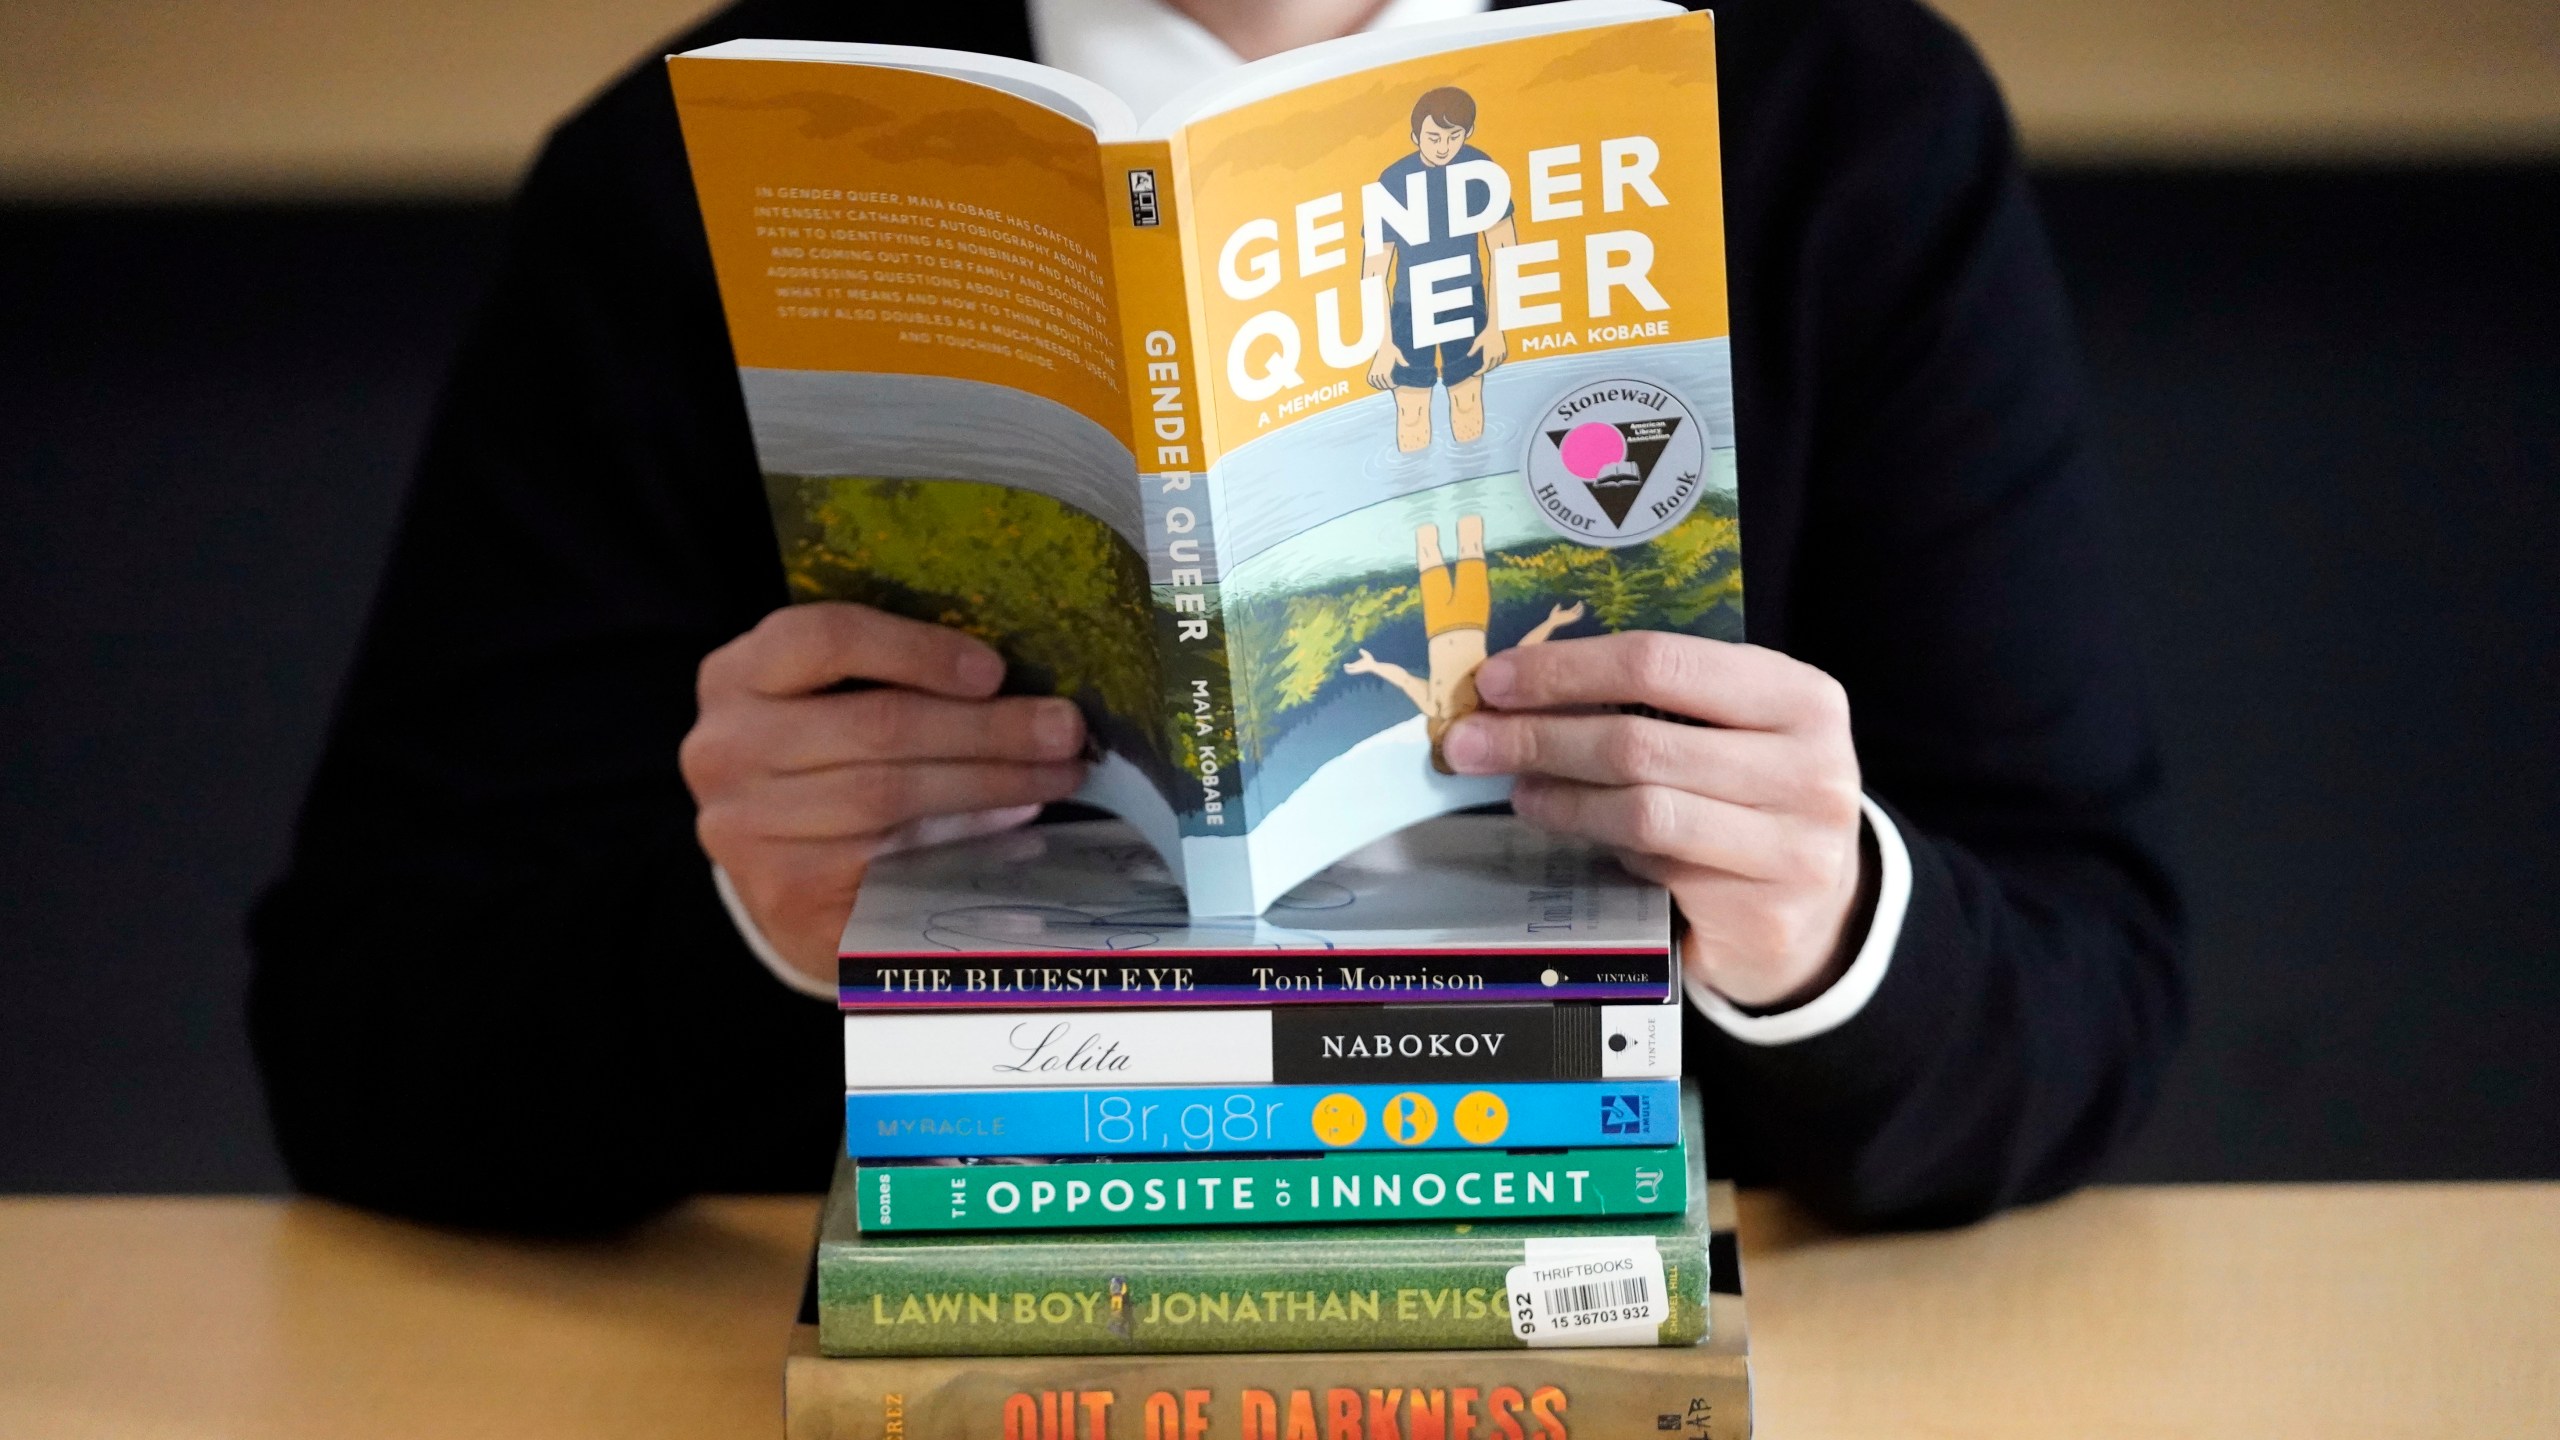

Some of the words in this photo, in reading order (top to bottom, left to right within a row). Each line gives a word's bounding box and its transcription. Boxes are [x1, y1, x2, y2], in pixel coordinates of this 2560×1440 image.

[755, 187, 774, 198] IN
[777, 187, 842, 200] GENDER
[847, 191, 904, 206] QUEER,
[907, 195, 945, 210] MAIA
[948, 201, 1003, 223] KOBABE
[1006, 215, 1031, 232] HAS
[1033, 224, 1082, 255] CRAFTED
[1085, 249, 1098, 264] AN
[1217, 135, 1670, 301] GENDER
[754, 206, 841, 221] INTENSELY
[847, 210, 936, 228] CATHARTIC
[939, 219, 1050, 257] AUTOBIOGRAPHY
[1053, 251, 1087, 277] ABOUT
[1089, 270, 1104, 287] EIR
[756, 226, 800, 238] PATH
[803, 227, 826, 240] TO
[830, 229, 932, 248] IDENTIFYING
[935, 238, 953, 250] AS
[956, 241, 1035, 269] NONBINARY
[1038, 263, 1061, 281] AND
[767, 266, 869, 281] ADDRESSING
[873, 271, 962, 290] QUESTIONS
[966, 281, 1011, 300] ABOUT
[1015, 293, 1063, 320] GENDER
[771, 247, 805, 259] AND
[808, 247, 874, 262] COMING
[877, 251, 910, 264] OUT
[913, 254, 936, 267] TO
[940, 257, 963, 271] EIR
[966, 262, 1016, 283] FAMILY
[1019, 277, 1045, 293] AND
[1095, 311, 1107, 326] BY
[776, 287, 822, 298] WHAT
[827, 288, 843, 299] IT
[847, 288, 901, 302] MEANS
[905, 293, 937, 306] AND
[941, 297, 977, 311] HOW
[981, 302, 1000, 316] TO
[1002, 307, 1042, 329] THINK
[1045, 321, 1082, 346] ABOUT
[777, 306, 830, 318] STORY
[834, 308, 877, 321] ALSO
[880, 310, 954, 327] DOUBLES
[956, 318, 976, 330] AS
[979, 320, 988, 332] A
[1226, 230, 1672, 401] QUEER
[1522, 332, 1578, 353] MAIA
[1587, 320, 1670, 345] KOBABE
[899, 330, 932, 344] AND
[935, 334, 1013, 358] TOUCHING
[1145, 330, 1192, 494] GENDER
[1257, 410, 1272, 428] A
[1278, 381, 1350, 418] MEMOIR
[1557, 388, 1668, 422] Stonewall
[1630, 421, 1667, 429] American
[1627, 434, 1670, 442] Association
[1537, 483, 1597, 531] Honor
[1650, 471, 1697, 519] Book
[1165, 506, 1208, 643] QUEER
[1191, 680, 1213, 737] MAIA
[1199, 746, 1225, 825] KOBABE
[877, 968, 952, 993] THE
[964, 967, 1108, 992] BLUEST
[1120, 967, 1195, 992] EYE
[1252, 967, 1324, 992] Toni
[1339, 967, 1485, 992] Morrison
[1596, 973, 1649, 982] VINTAGE
[992, 1021, 1133, 1075] Lolita
[1321, 1033, 1505, 1059] NABOKOV
[1647, 1017, 1656, 1067] VINTAGE
[877, 1117, 1006, 1137] MYRACLE
[1642, 1095, 1650, 1133] AMULET
[879, 1174, 892, 1225] sones
[951, 1178, 966, 1218] THE
[986, 1177, 1255, 1214] OPPOSITE
[1275, 1178, 1291, 1207] OF
[1310, 1170, 1590, 1208] INNOCENT
[1533, 1258, 1634, 1283] THRIFTBOOKS
[1669, 1265, 1678, 1290] HILL
[872, 1291, 998, 1326] LAWN
[1013, 1291, 1101, 1325] BOY
[1143, 1288, 1379, 1325] JONATHAN
[1516, 1292, 1536, 1334] 932
[1551, 1317, 1569, 1329] 15
[1573, 1309, 1618, 1326] 36703
[1622, 1305, 1650, 1320] 932
[1669, 1293, 1678, 1334] CHAPEL
[1004, 1391, 1114, 1440] OUT
[1144, 1389, 1211, 1440] OF
[1242, 1386, 1567, 1440] DARKNESS
